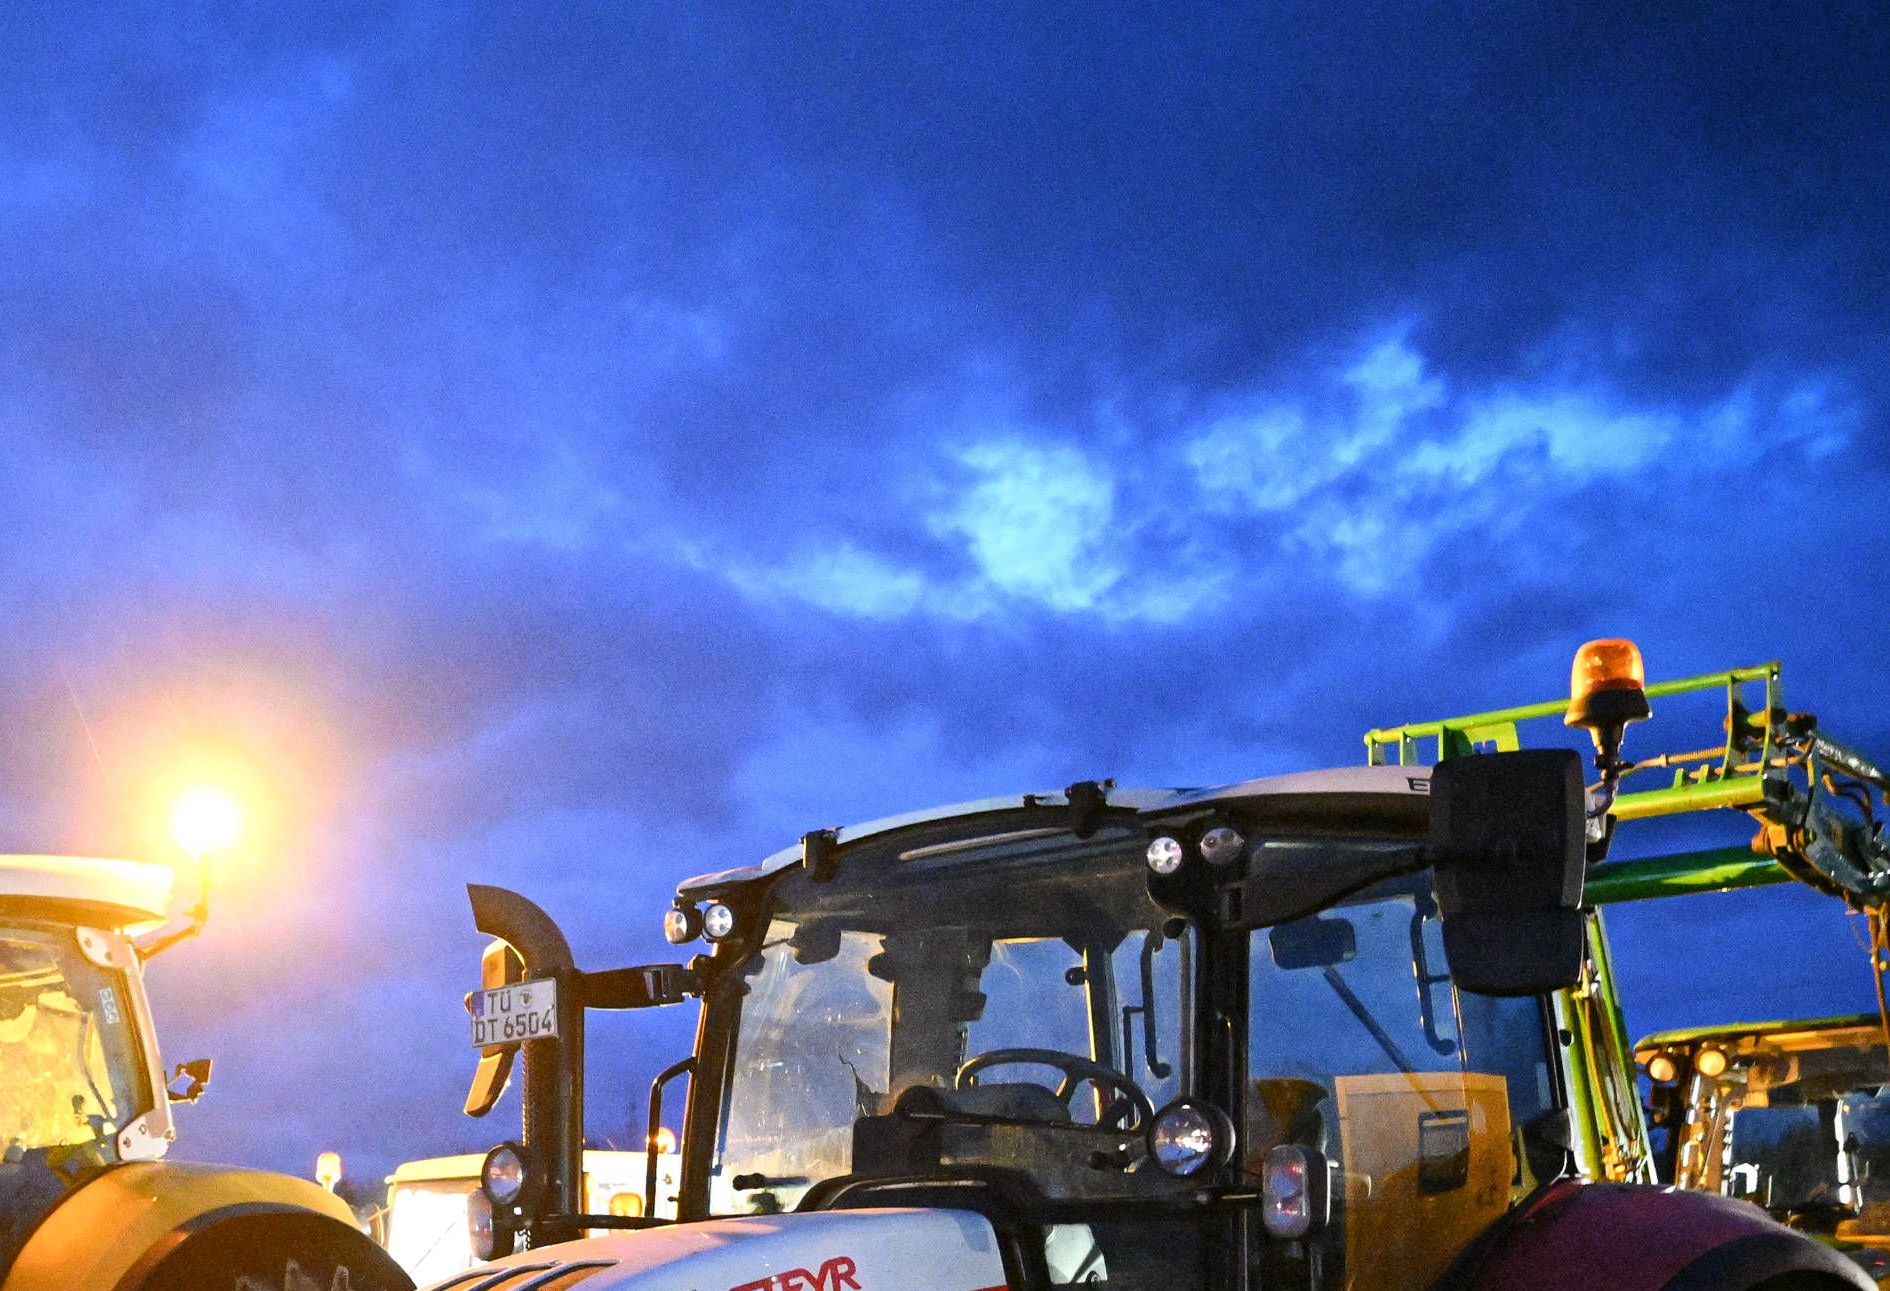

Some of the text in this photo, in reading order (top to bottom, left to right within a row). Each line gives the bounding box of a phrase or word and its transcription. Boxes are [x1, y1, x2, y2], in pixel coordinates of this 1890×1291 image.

[488, 989, 510, 1014] TÜ
[474, 1004, 555, 1042] DT 6504
